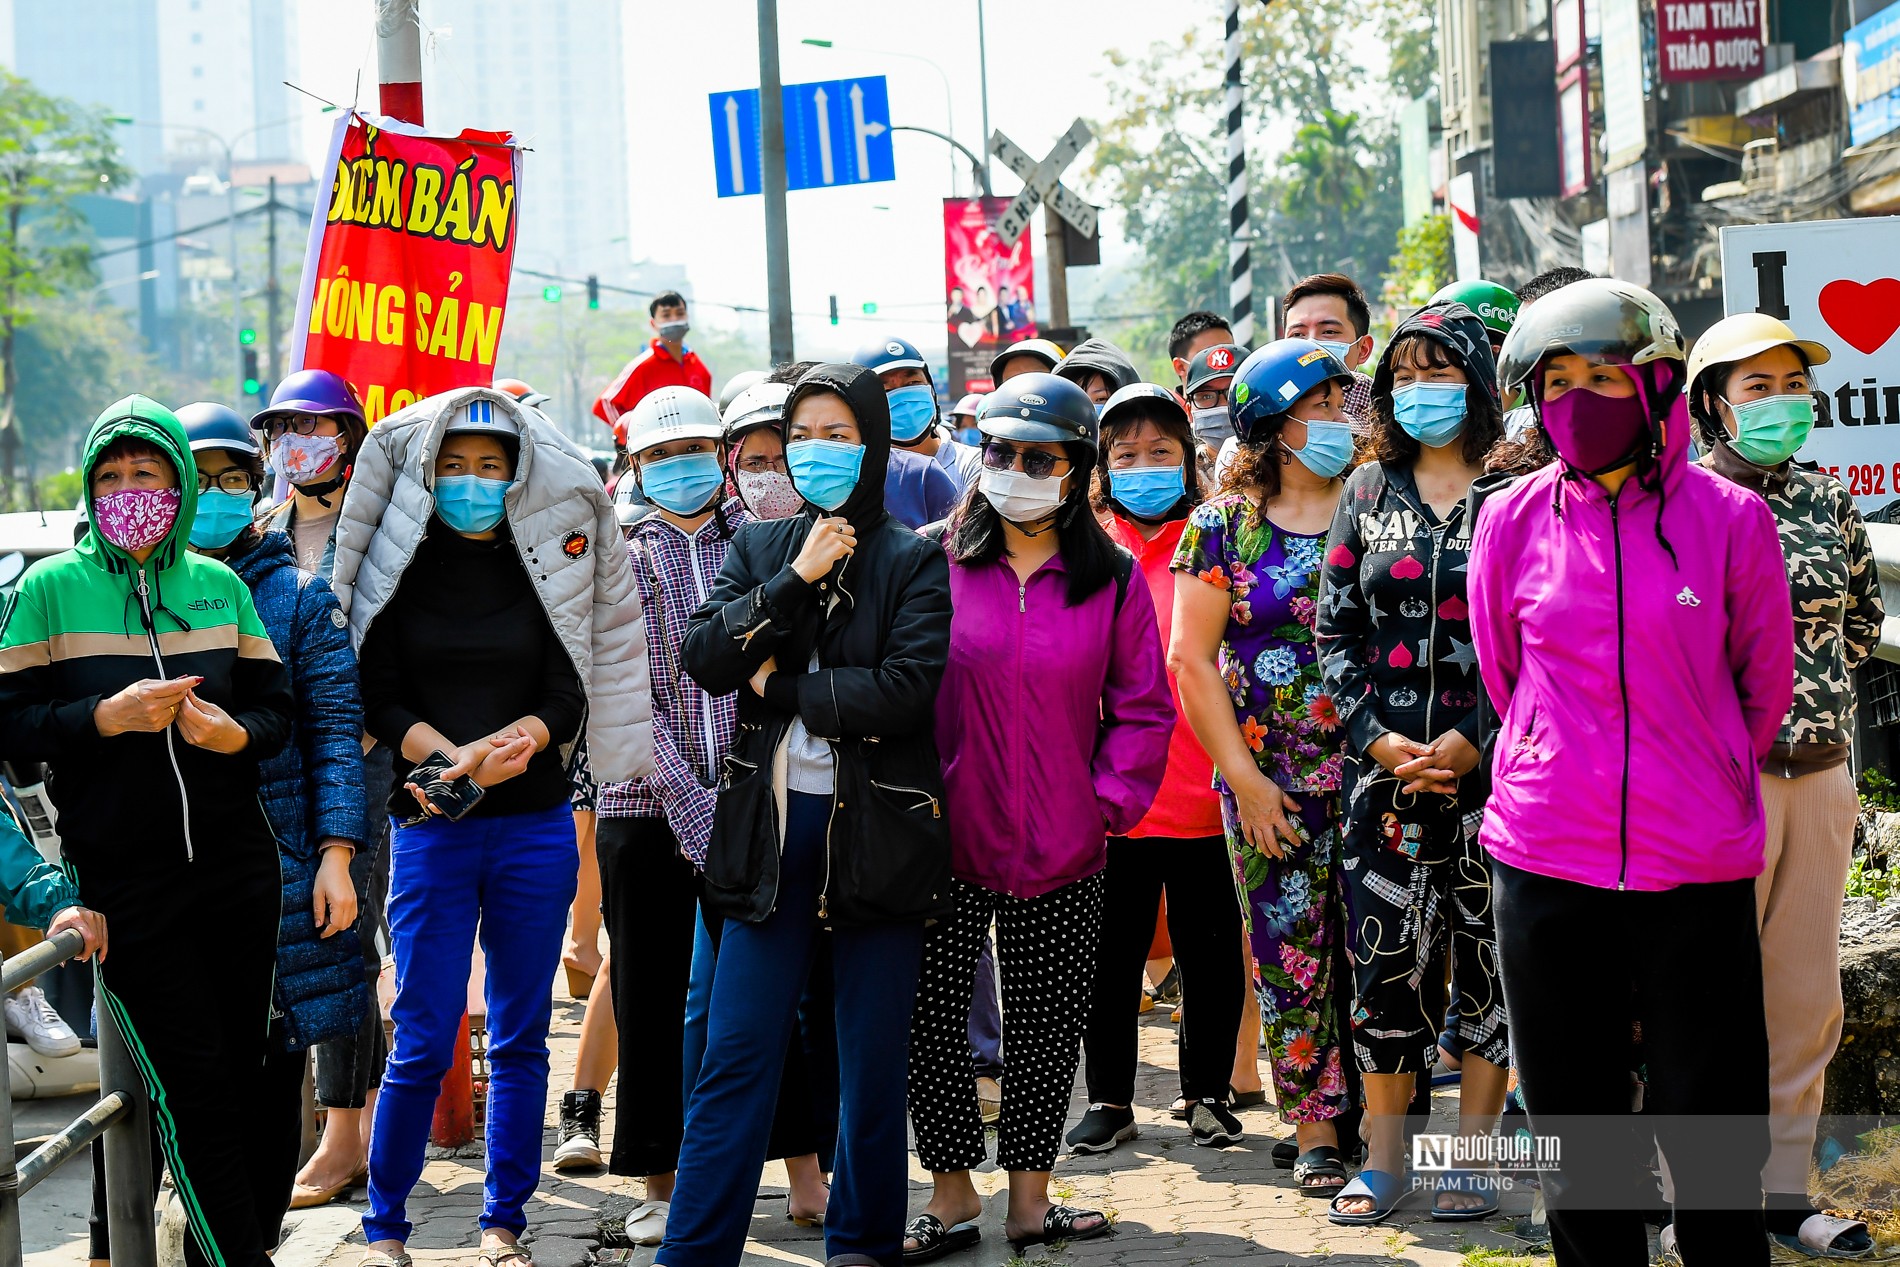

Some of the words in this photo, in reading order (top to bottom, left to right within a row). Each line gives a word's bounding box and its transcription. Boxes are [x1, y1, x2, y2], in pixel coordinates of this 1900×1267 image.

[1666, 34, 1710, 71] THẢO
[407, 158, 514, 249] BÁN
[1752, 251, 1790, 321] I
[415, 271, 502, 365] SẢN
[1478, 302, 1517, 325] Grab
[1848, 464, 1886, 496] 292
